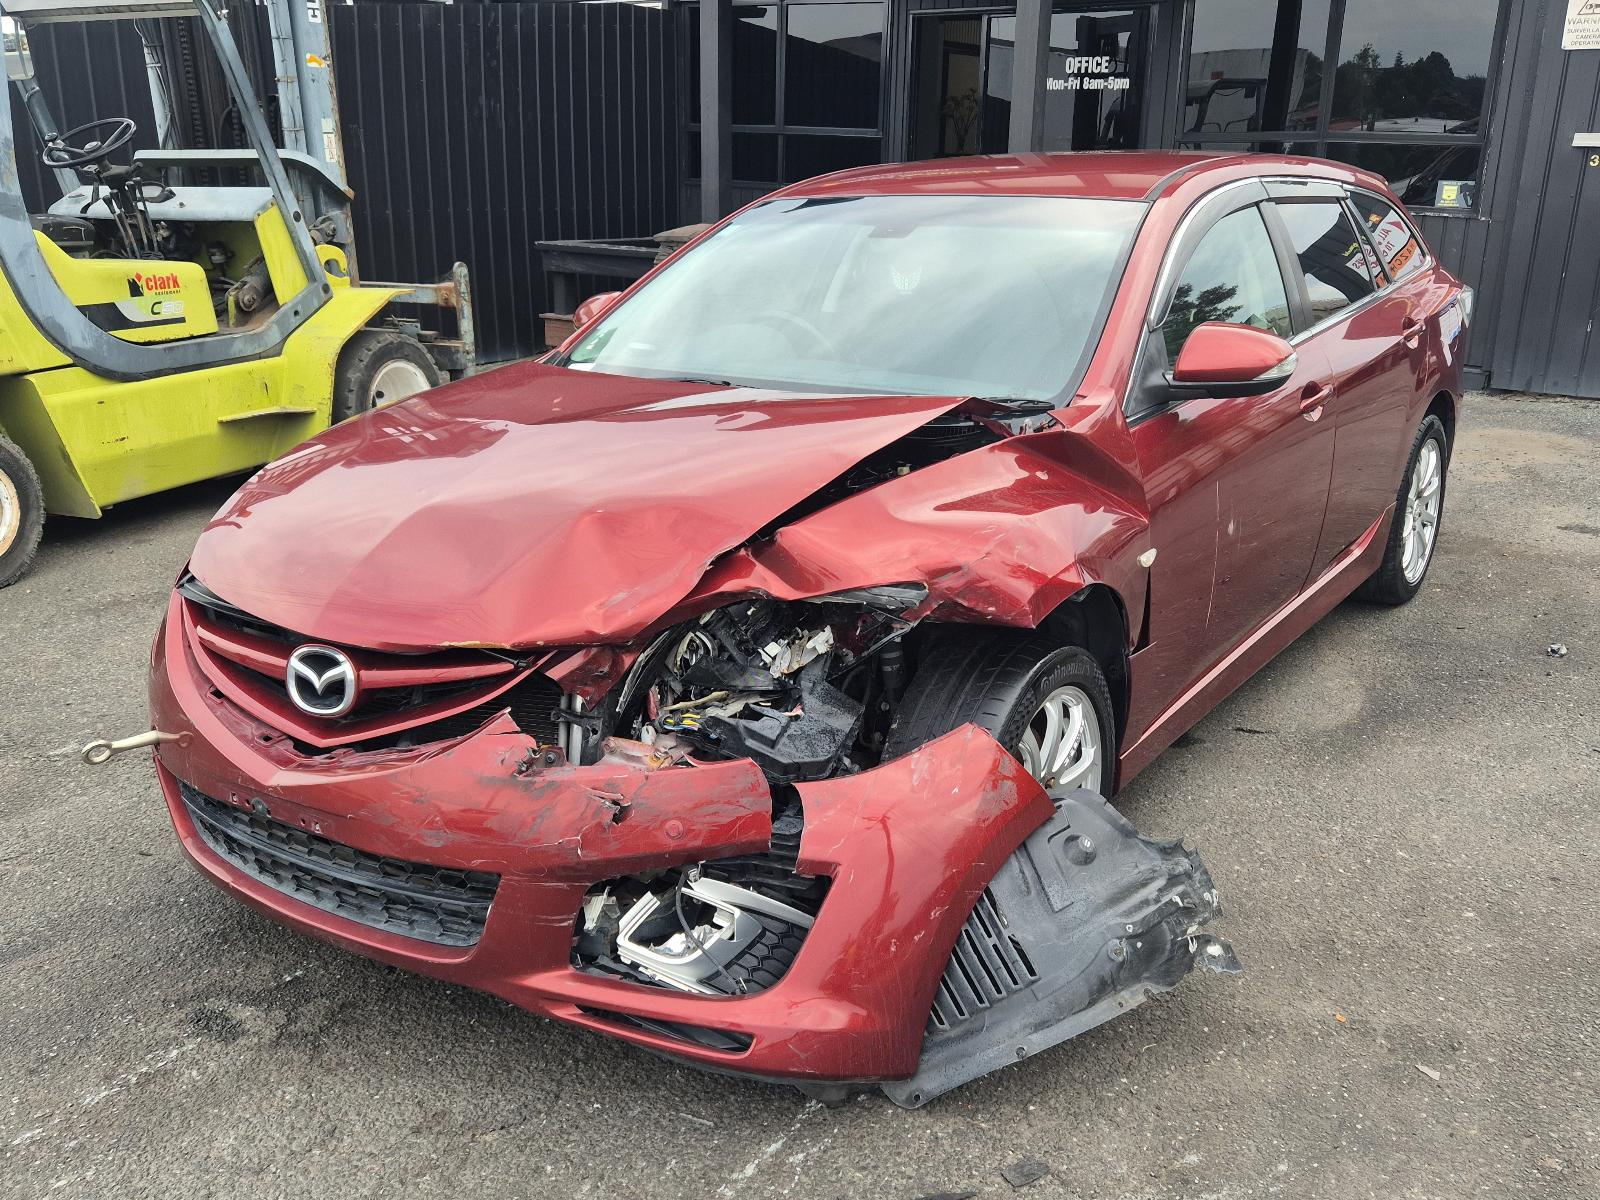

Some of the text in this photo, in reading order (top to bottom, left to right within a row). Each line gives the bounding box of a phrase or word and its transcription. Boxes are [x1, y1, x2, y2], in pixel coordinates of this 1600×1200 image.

[1065, 56, 1110, 74] OFFICE
[1082, 76, 1130, 91] 8am-5pm
[145, 273, 180, 291] clark
